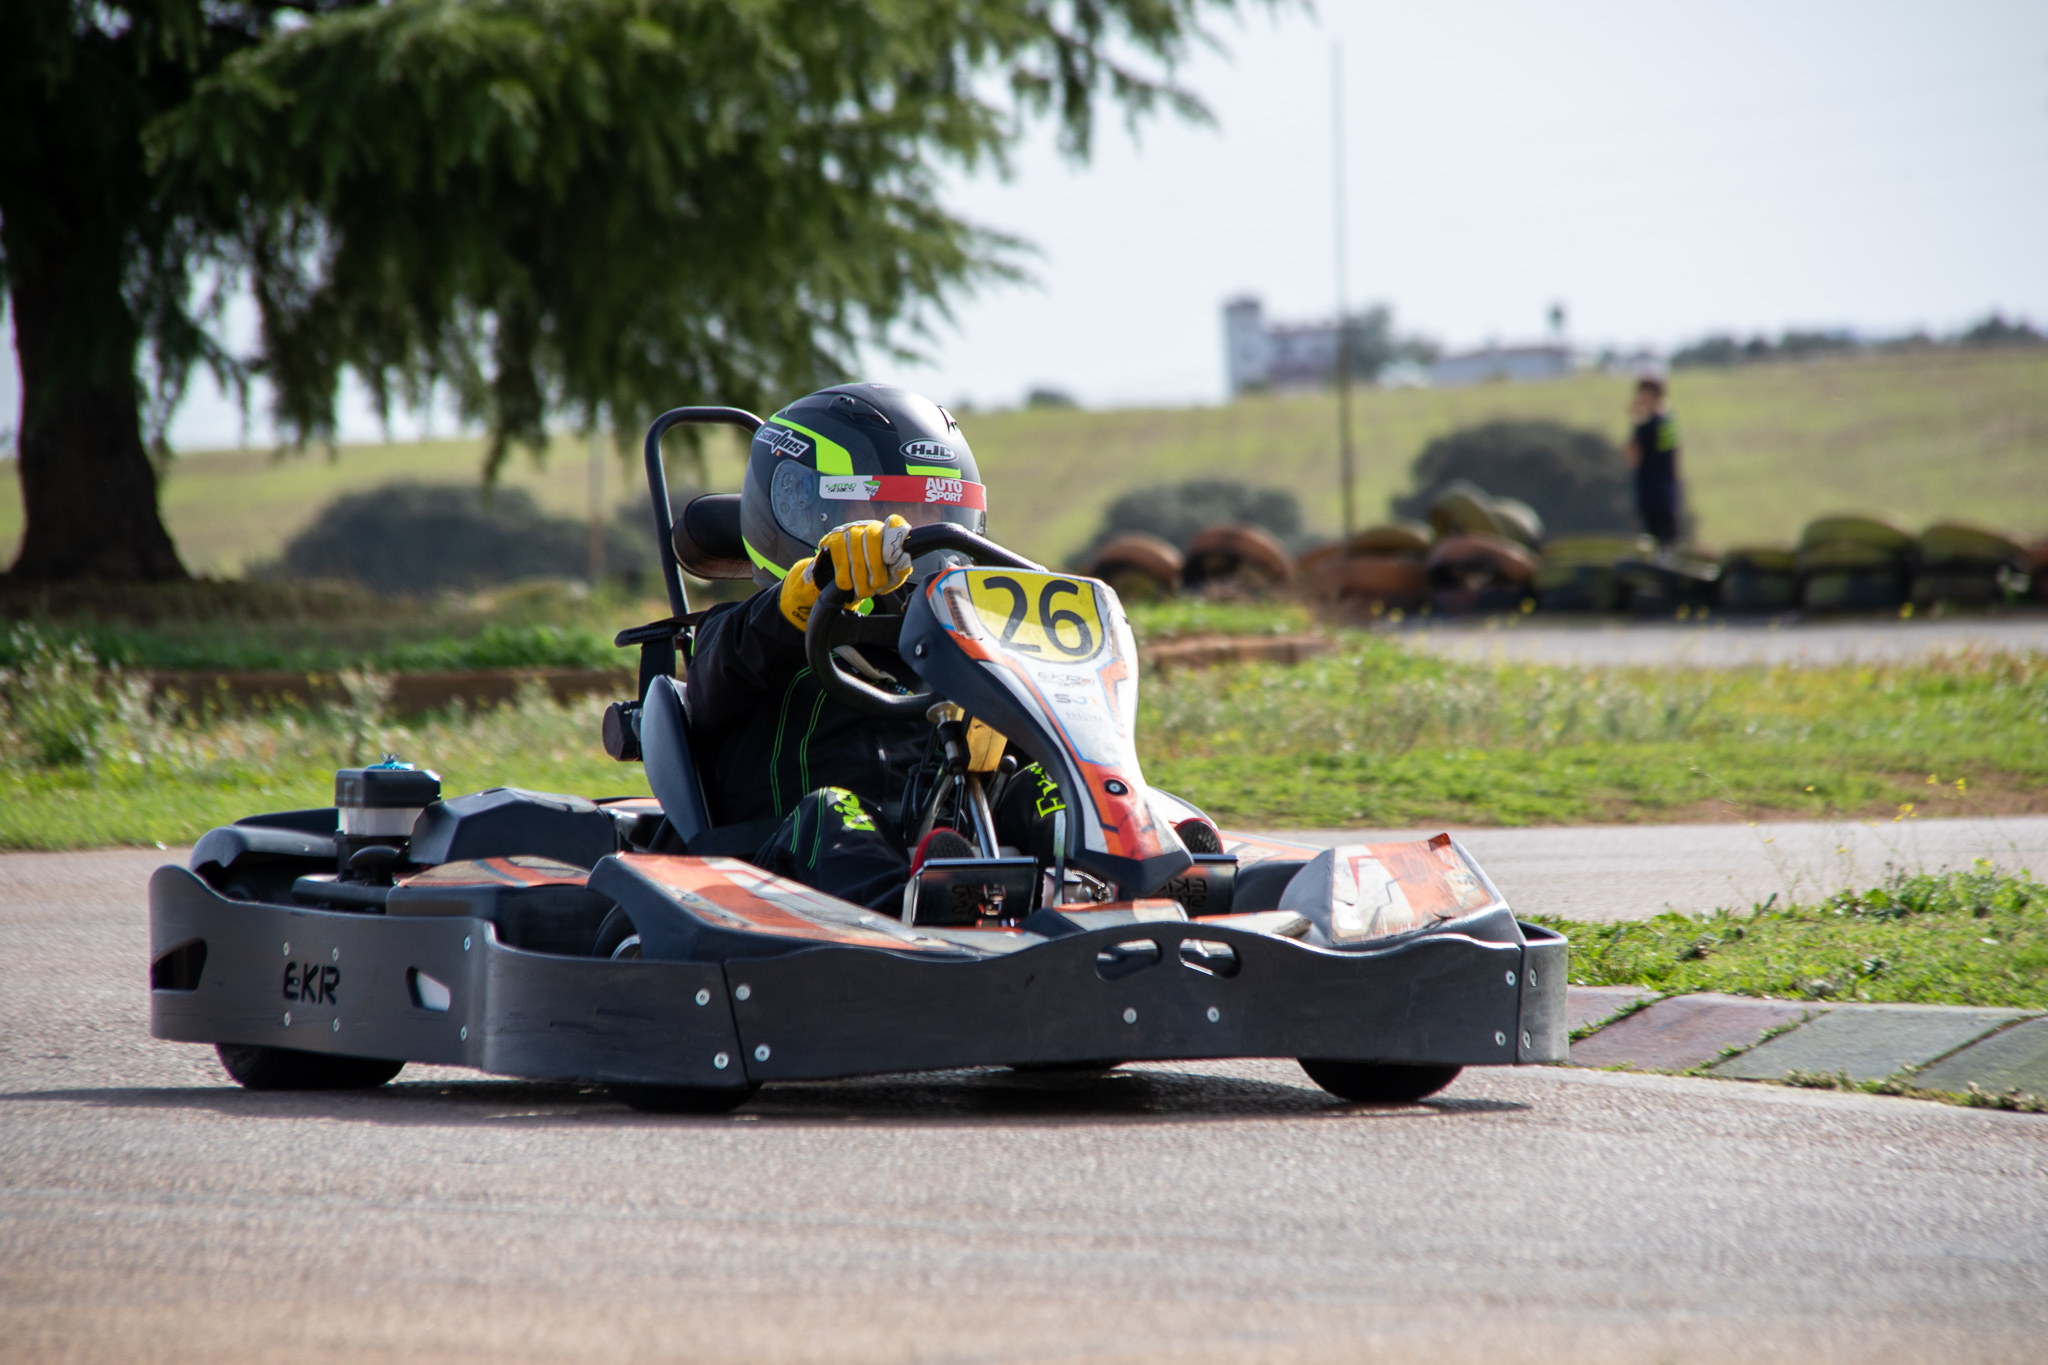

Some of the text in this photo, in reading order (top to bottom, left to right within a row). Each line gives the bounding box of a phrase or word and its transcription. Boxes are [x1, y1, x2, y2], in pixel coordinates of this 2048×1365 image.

[910, 444, 952, 458] HJC
[925, 477, 963, 493] AUTO
[925, 489, 963, 503] SPORT
[983, 576, 1093, 657] 26
[282, 961, 341, 1006] EKR
